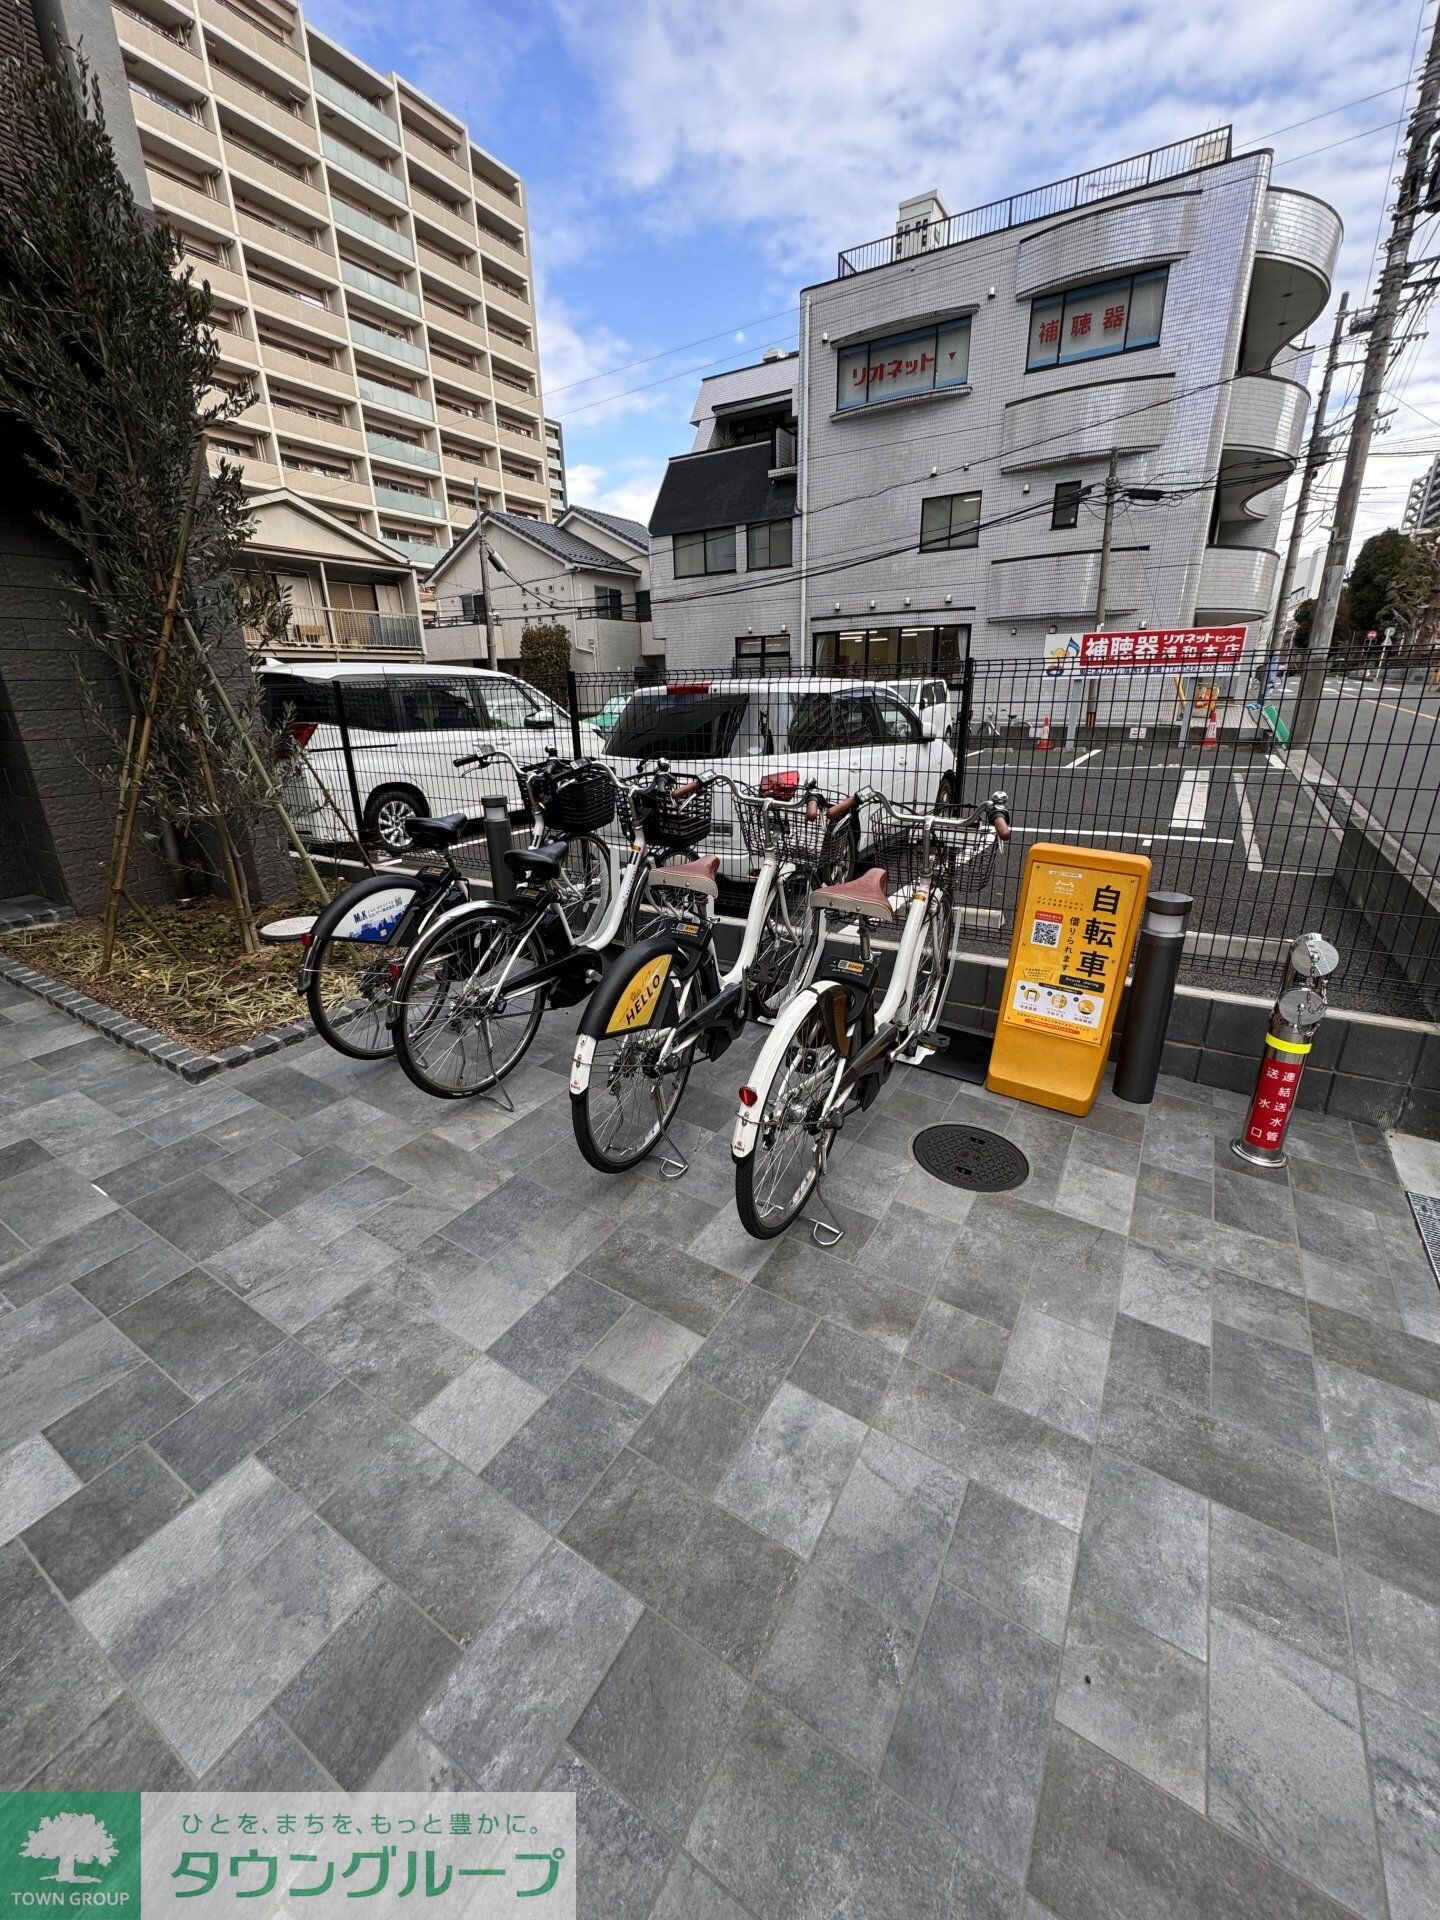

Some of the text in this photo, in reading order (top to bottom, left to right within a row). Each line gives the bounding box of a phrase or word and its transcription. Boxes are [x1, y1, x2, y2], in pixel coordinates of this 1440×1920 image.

[1038, 305, 1125, 344] 補聴器
[852, 353, 935, 388] リオネット
[1085, 635, 1159, 661] 補聴器
[1161, 643, 1241, 659] 浦和本店
[1162, 632, 1242, 646] リオネットセンター
[1061, 916, 1081, 972] 借りられます
[1075, 884, 1122, 979] 自転車
[625, 974, 661, 1025] HELLO
[1250, 1066, 1280, 1138] 送水口
[1266, 1071, 1296, 1142] 連結送水管
